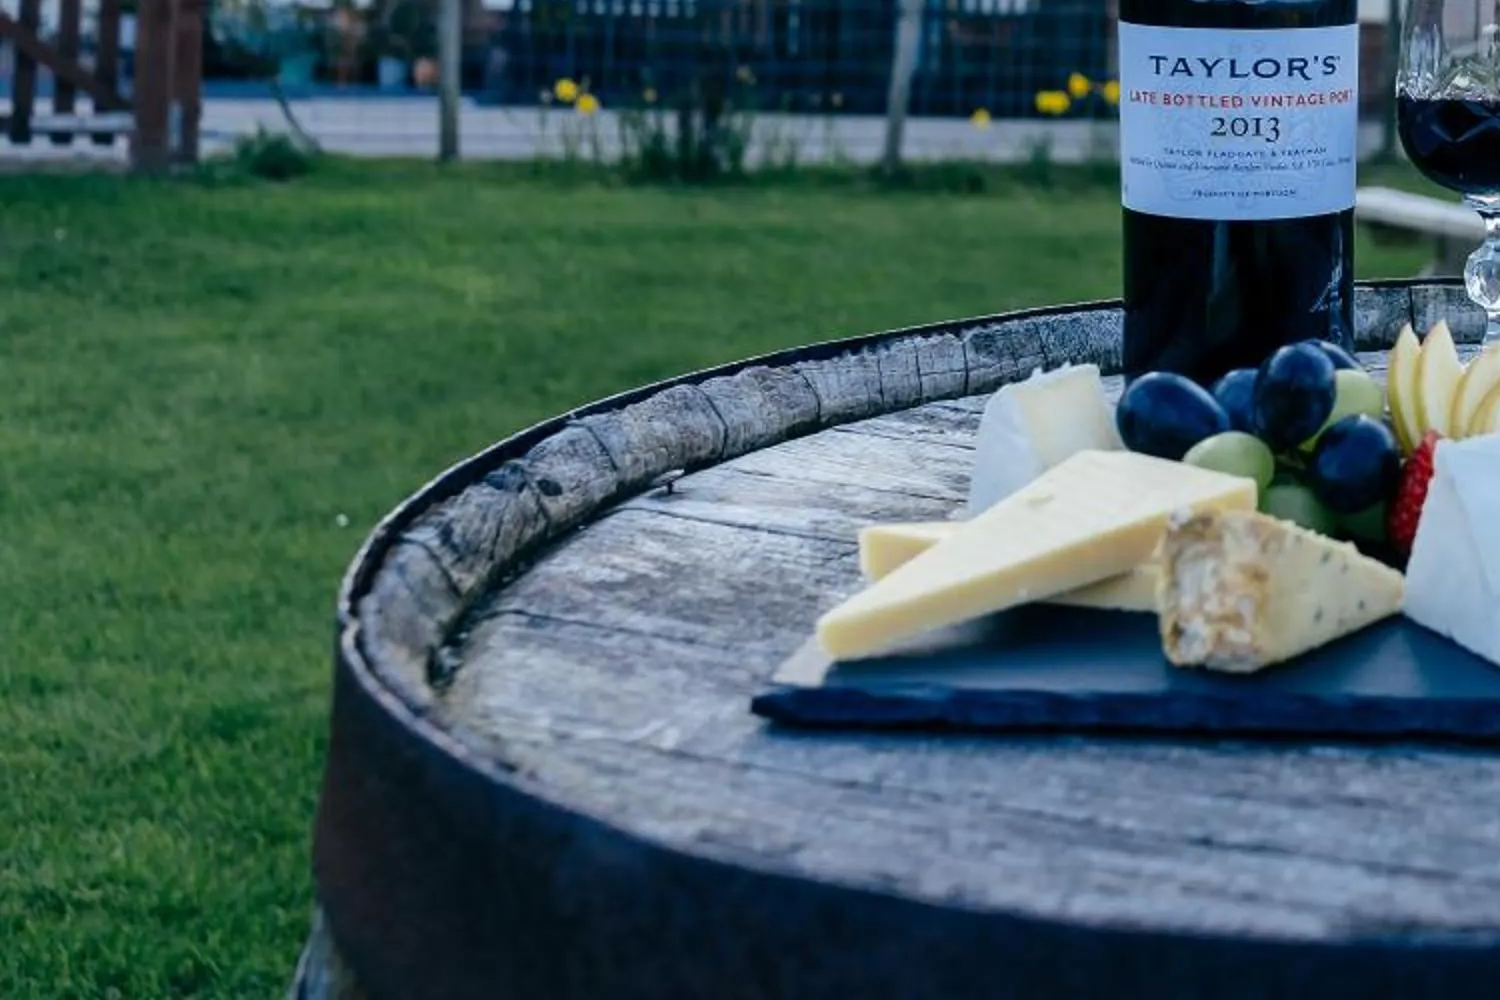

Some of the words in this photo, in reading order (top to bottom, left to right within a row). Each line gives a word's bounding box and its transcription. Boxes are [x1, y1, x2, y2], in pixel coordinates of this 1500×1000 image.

[1148, 54, 1338, 81] TAYLOR'S
[1129, 89, 1156, 105] LATE
[1163, 93, 1243, 108] BOTTLED
[1250, 94, 1325, 108] VINTAGE
[1210, 116, 1281, 143] 2013
